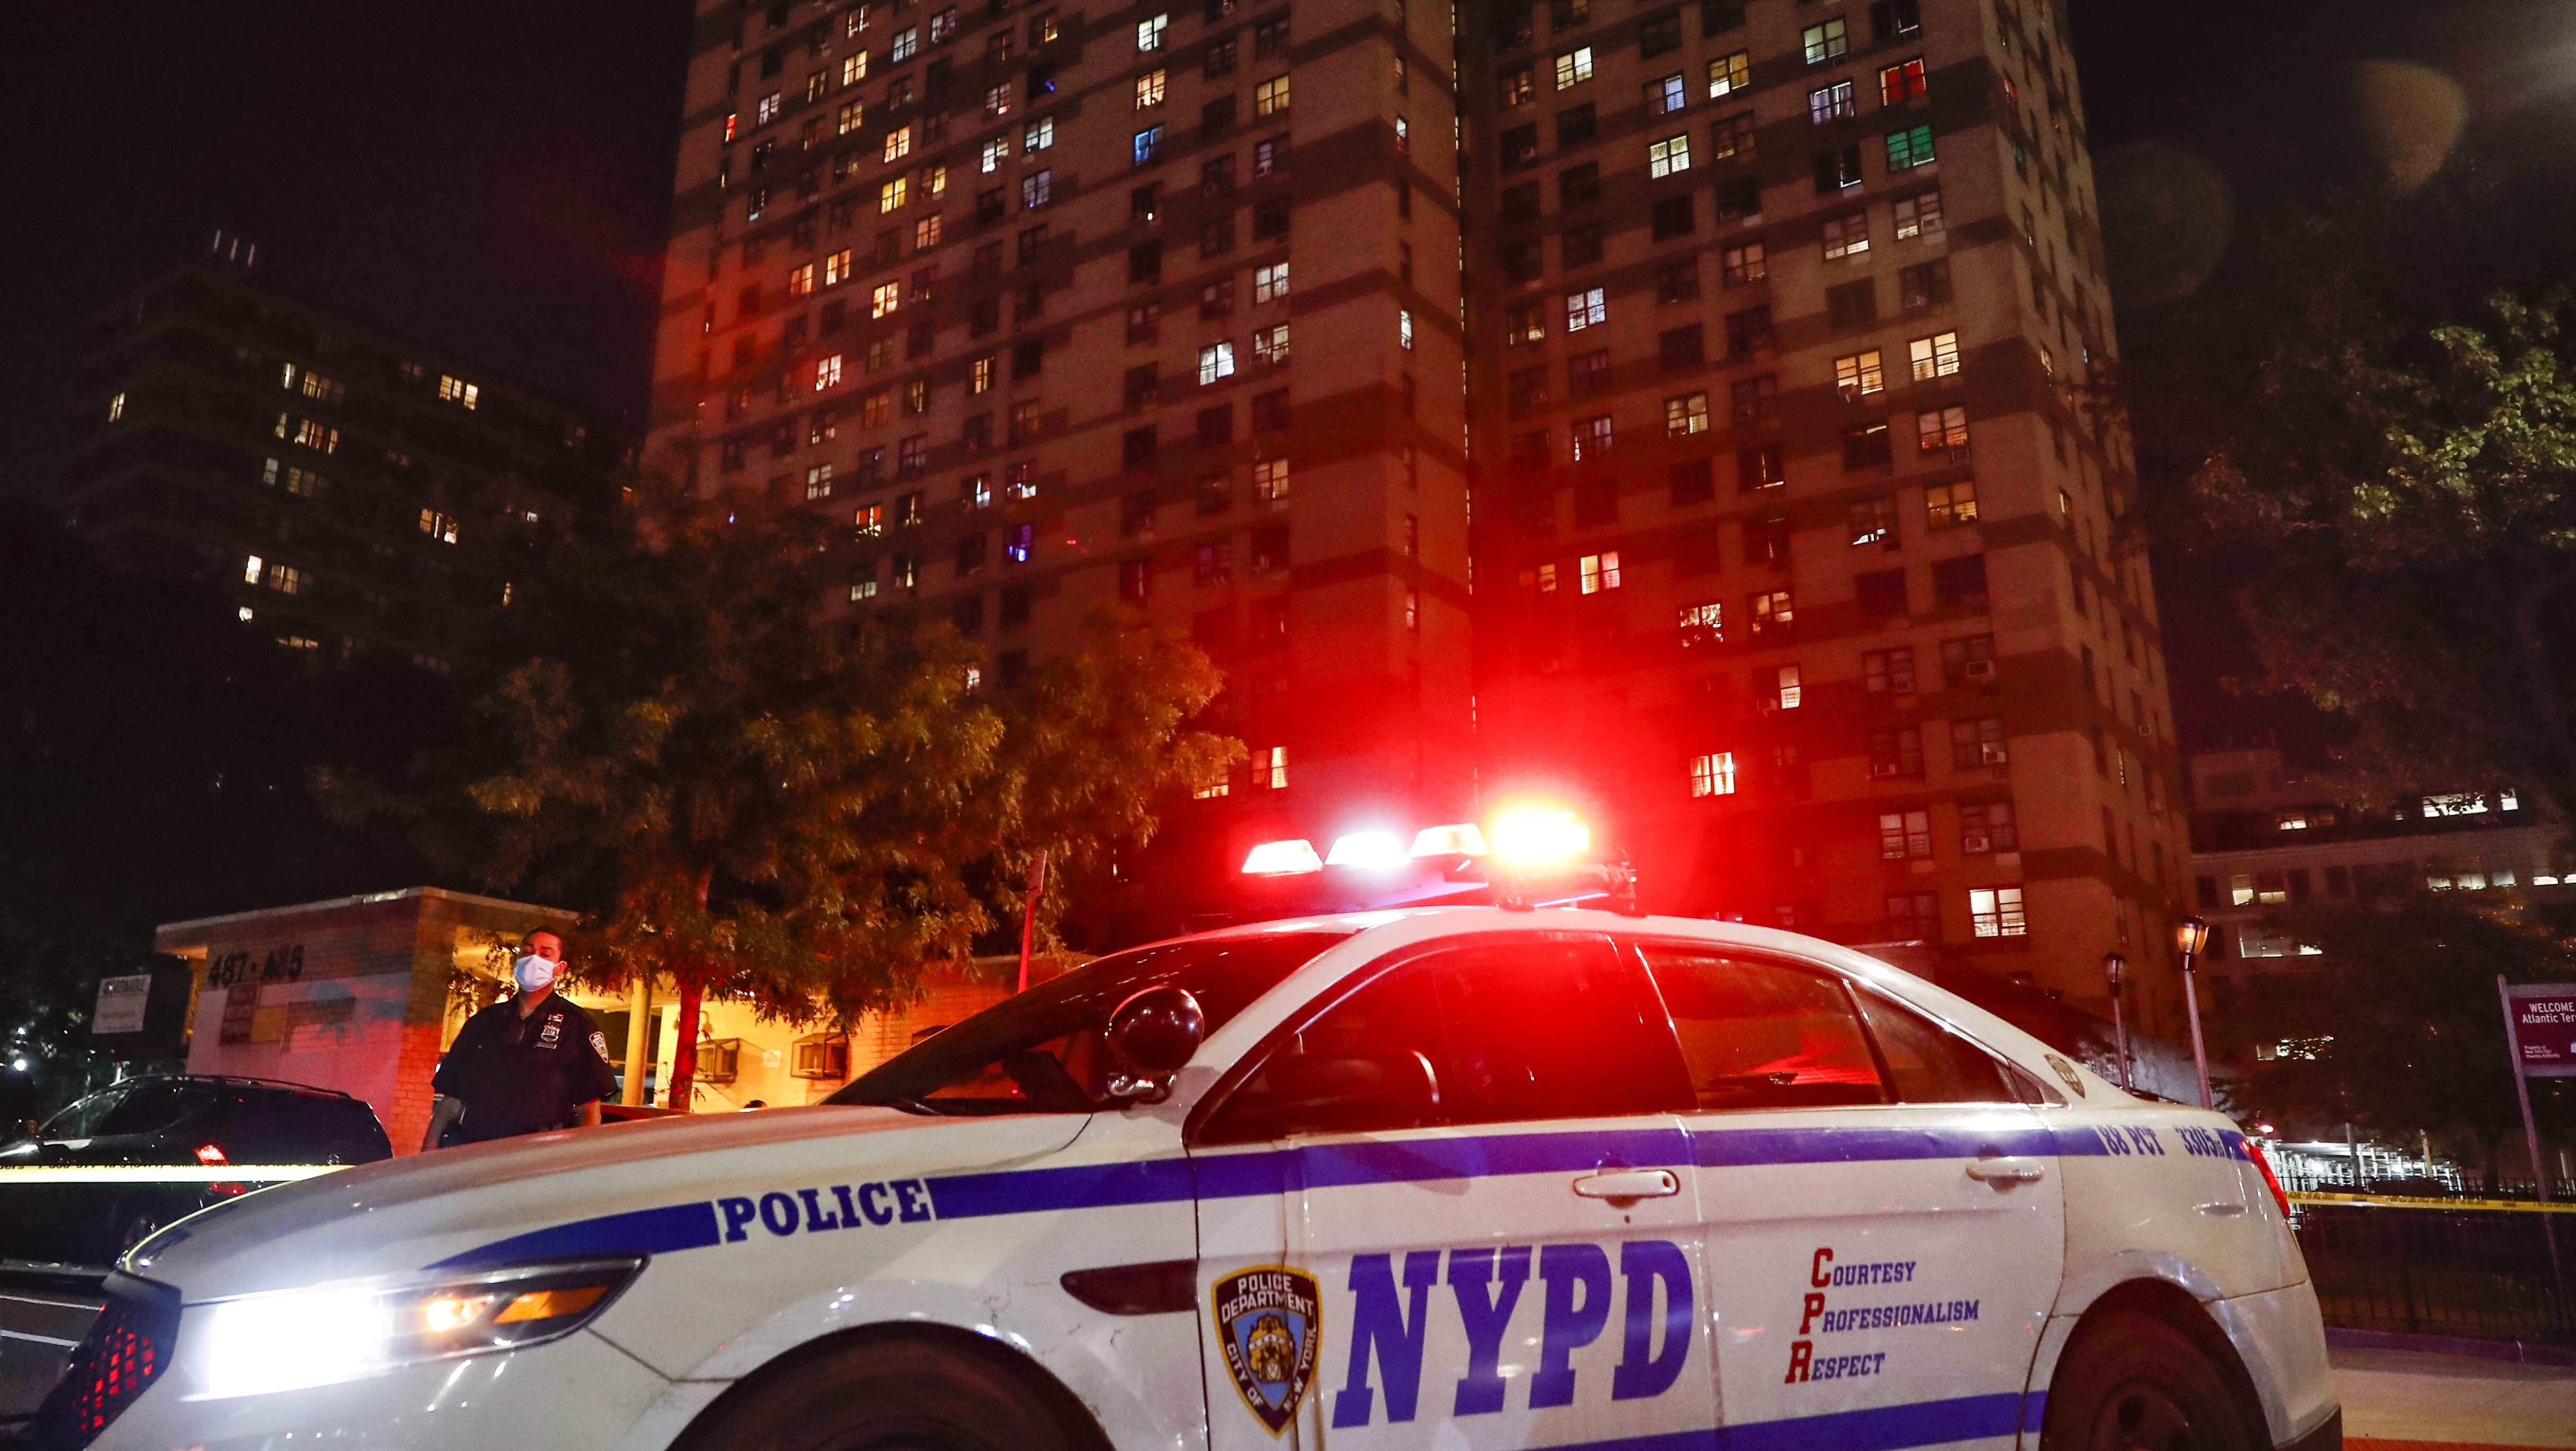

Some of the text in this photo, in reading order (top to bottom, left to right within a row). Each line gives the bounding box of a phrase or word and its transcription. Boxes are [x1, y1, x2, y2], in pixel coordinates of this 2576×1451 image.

[2523, 1013, 2559, 1024] Atlantic
[2529, 1002, 2575, 1013] WELCOME
[2121, 1124, 2165, 1155] PCT
[718, 1179, 929, 1243] POLICE
[1238, 1273, 1293, 1295] POLICE
[1221, 1290, 1314, 1324] DEPARTMENT
[1332, 1239, 1694, 1428] NYPD
[1227, 1343, 1249, 1382] CITY
[1247, 1386, 1264, 1408] OF
[1301, 1326, 1317, 1371] YORK
